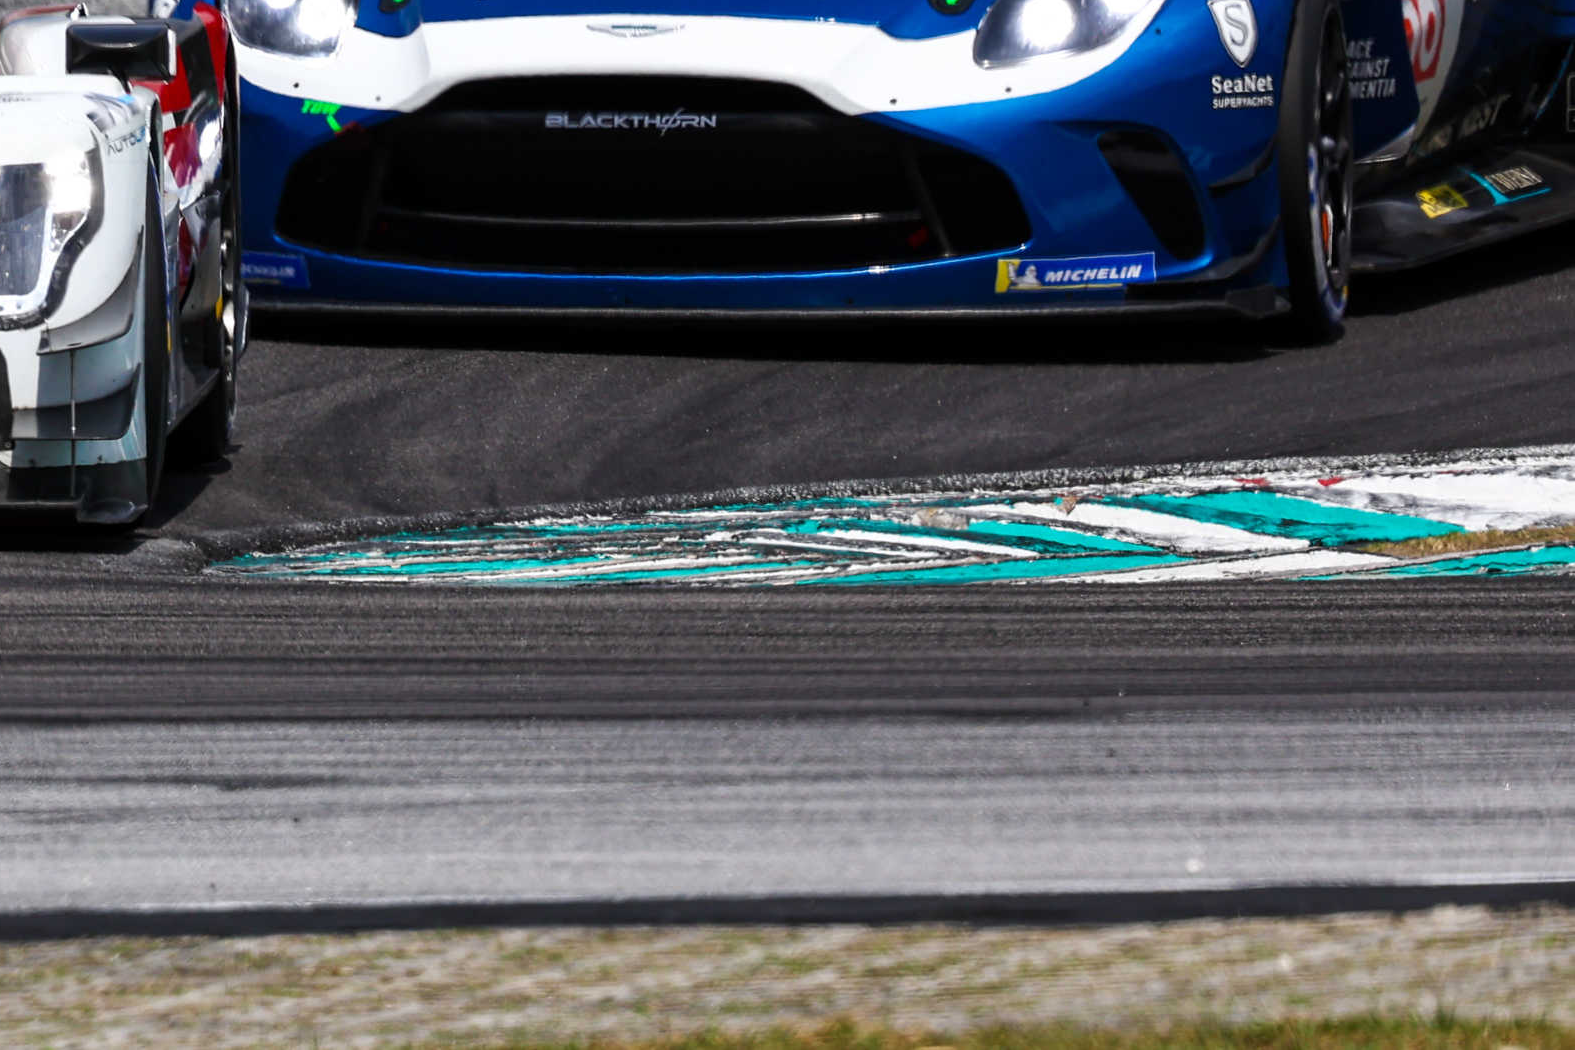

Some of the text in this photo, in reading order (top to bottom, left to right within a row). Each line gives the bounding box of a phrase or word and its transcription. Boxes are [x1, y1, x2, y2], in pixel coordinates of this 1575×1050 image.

[1211, 72, 1273, 94] SeaNet
[1212, 96, 1274, 109] SUPERYACHTS
[1045, 265, 1142, 283] MICHELIN
